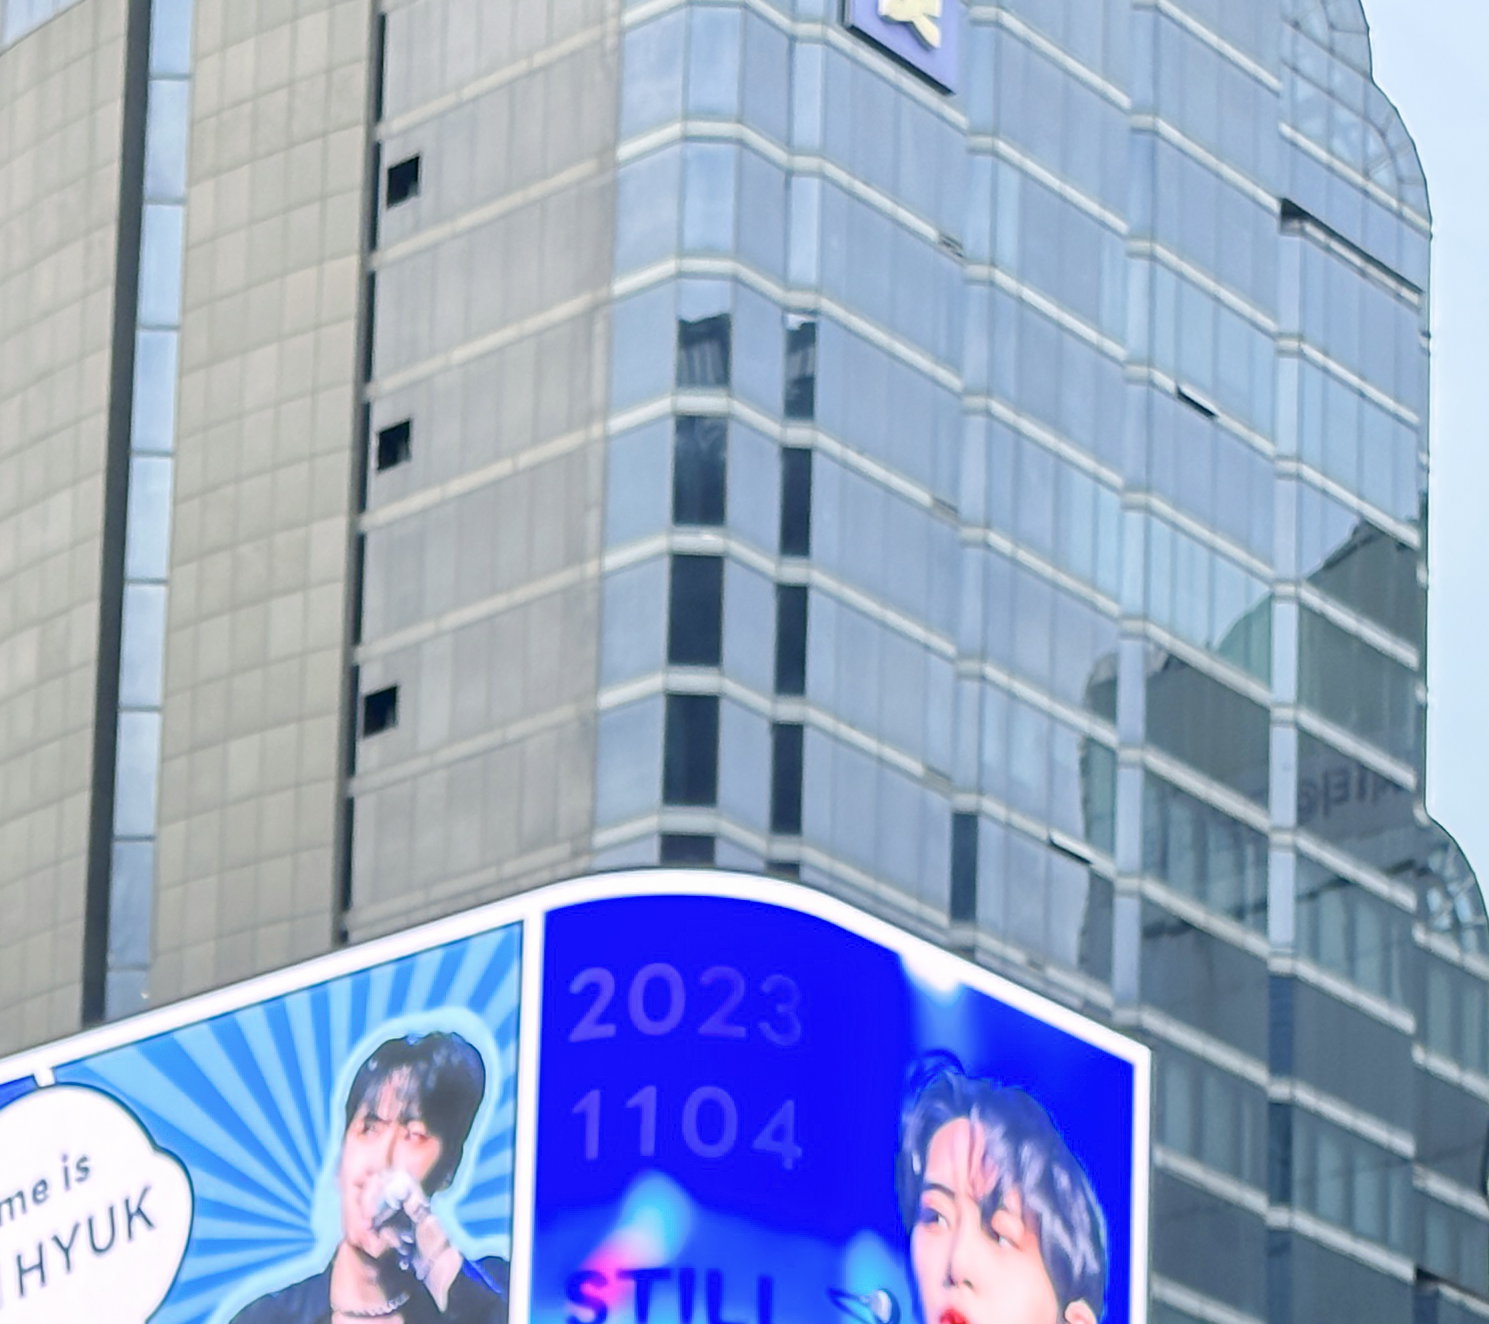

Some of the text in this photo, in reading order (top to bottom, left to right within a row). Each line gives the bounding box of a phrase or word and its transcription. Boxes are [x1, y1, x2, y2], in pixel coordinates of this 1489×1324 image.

[569, 963, 802, 1047] 2023
[572, 1085, 802, 1171] 1104
[61, 1153, 91, 1191] is
[16, 1185, 156, 1298] HYUK
